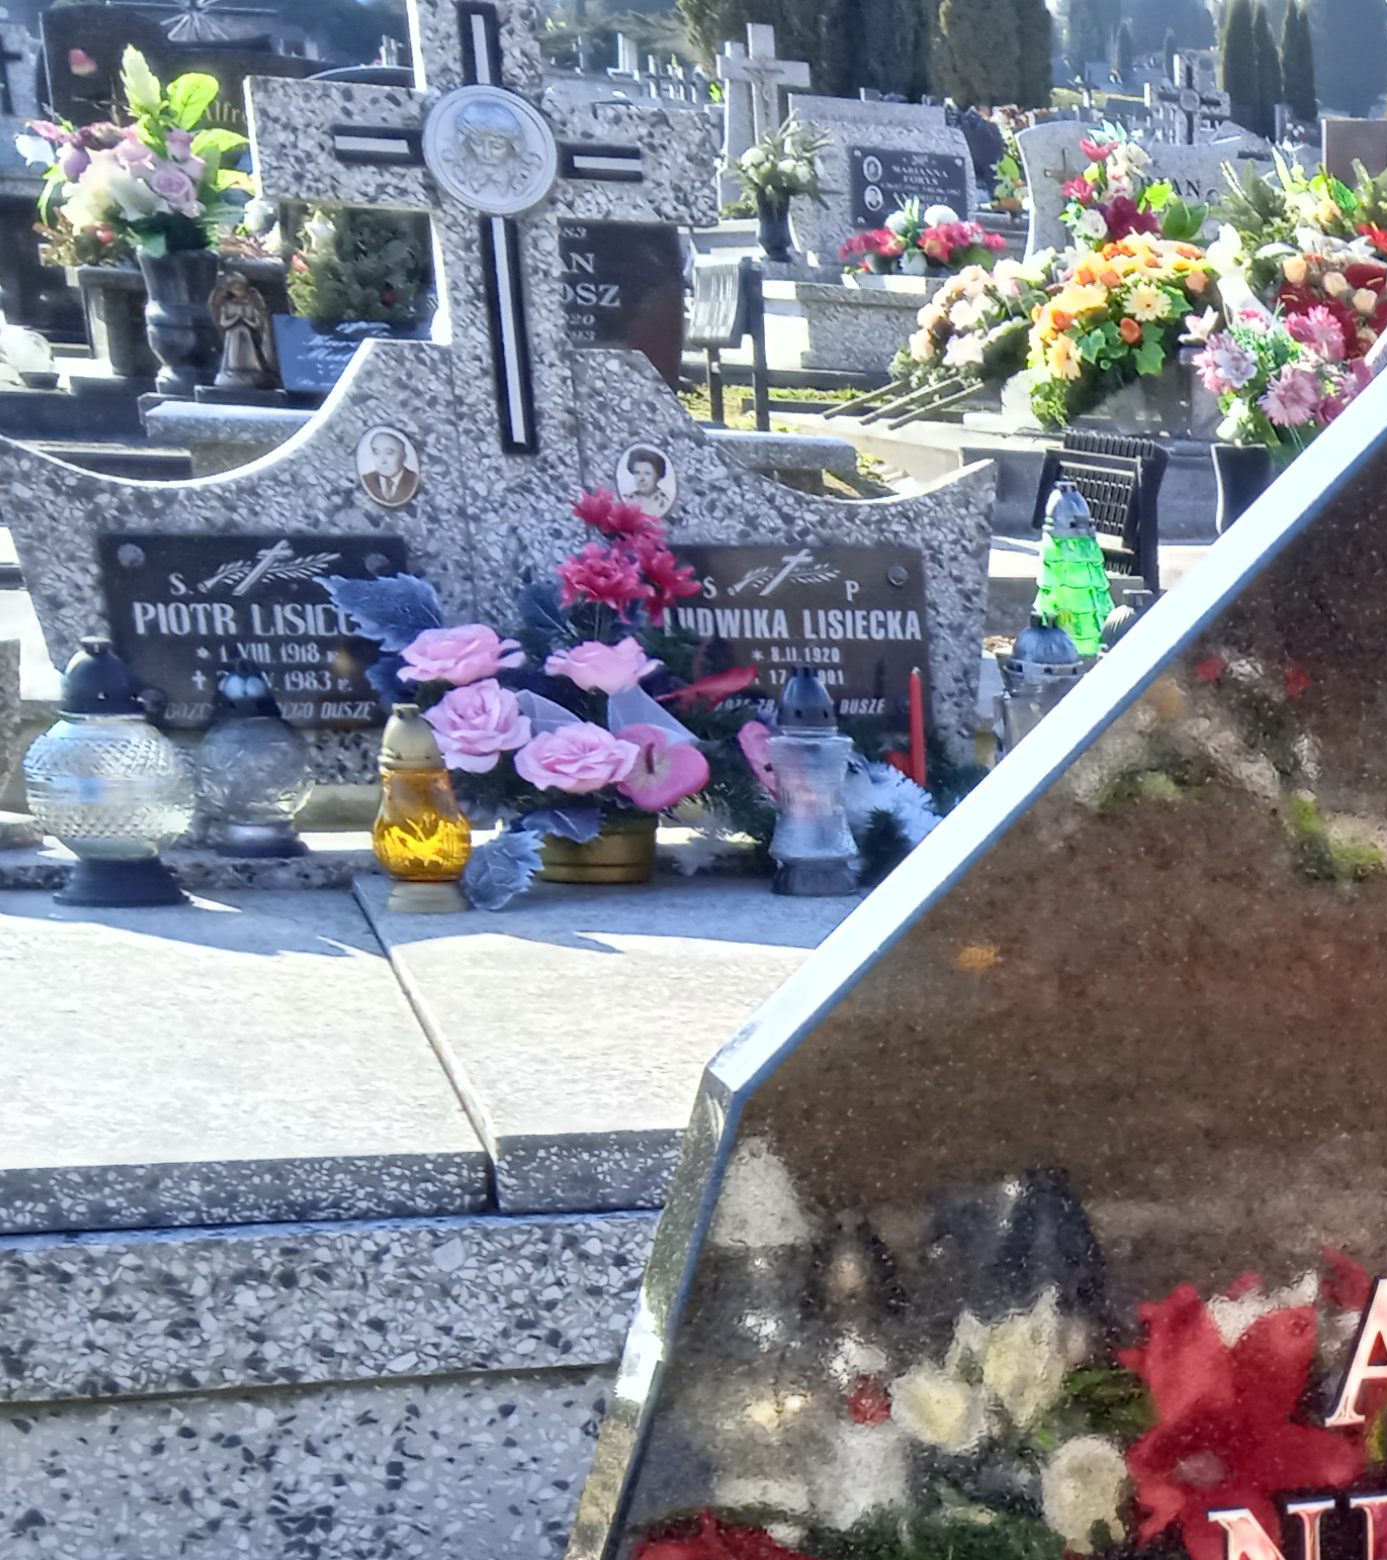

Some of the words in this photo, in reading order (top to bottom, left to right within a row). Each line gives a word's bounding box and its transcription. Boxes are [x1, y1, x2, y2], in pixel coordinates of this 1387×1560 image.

[131, 601, 238, 636] PIOTR
[663, 607, 790, 639] LUDWIKA
[803, 608, 923, 641] LISIECKA
[279, 642, 321, 664] 1918
[283, 670, 332, 692] 1983
